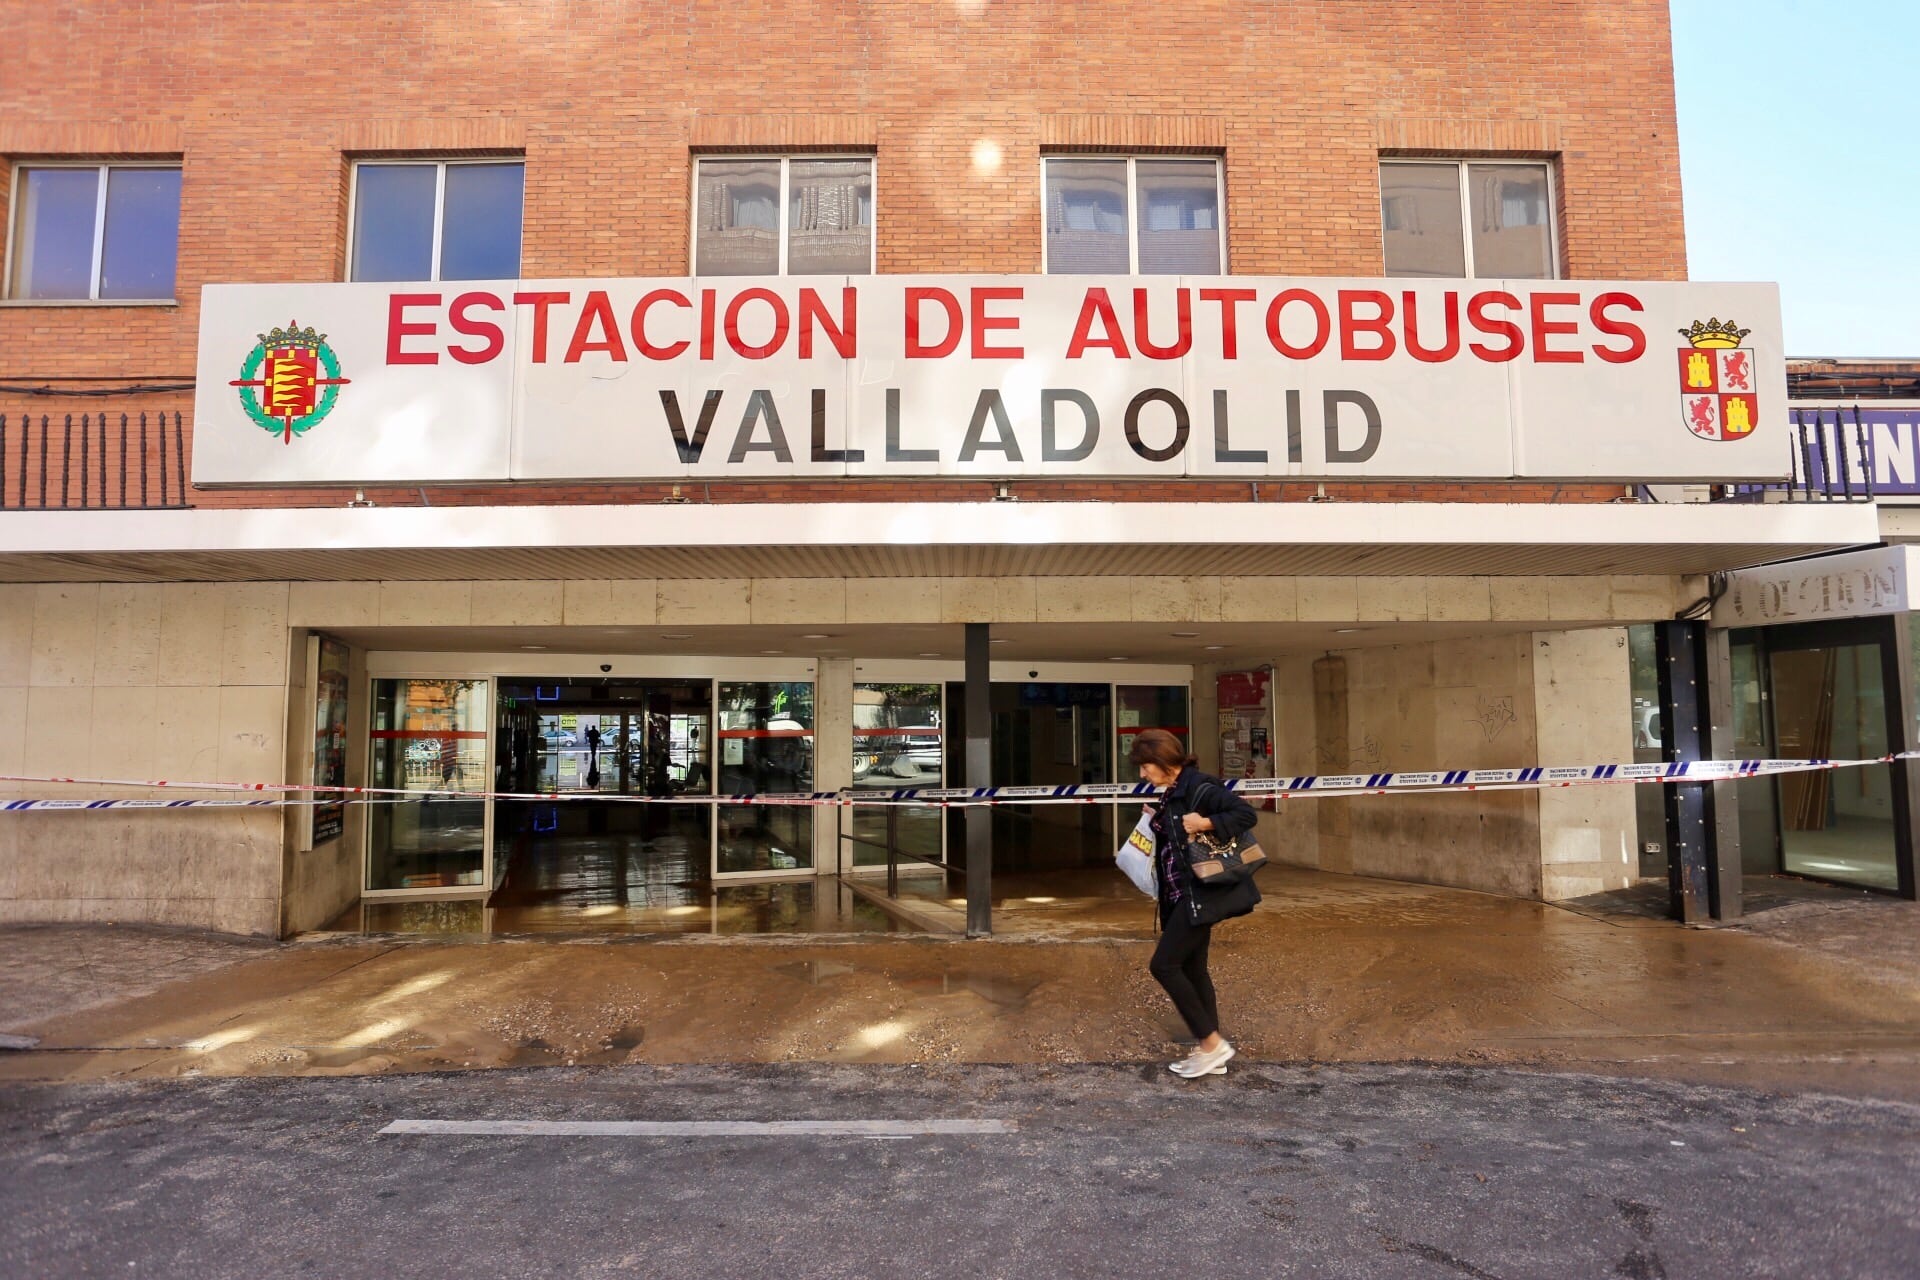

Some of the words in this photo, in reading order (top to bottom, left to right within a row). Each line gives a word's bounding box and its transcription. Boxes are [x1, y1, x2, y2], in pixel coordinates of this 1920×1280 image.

[386, 287, 857, 365] ESTACION
[904, 287, 1025, 360] DE
[1066, 287, 1647, 364] AUTOBUSES
[657, 387, 1382, 465] VALLADOLID
[1790, 423, 1920, 484] TIEN
